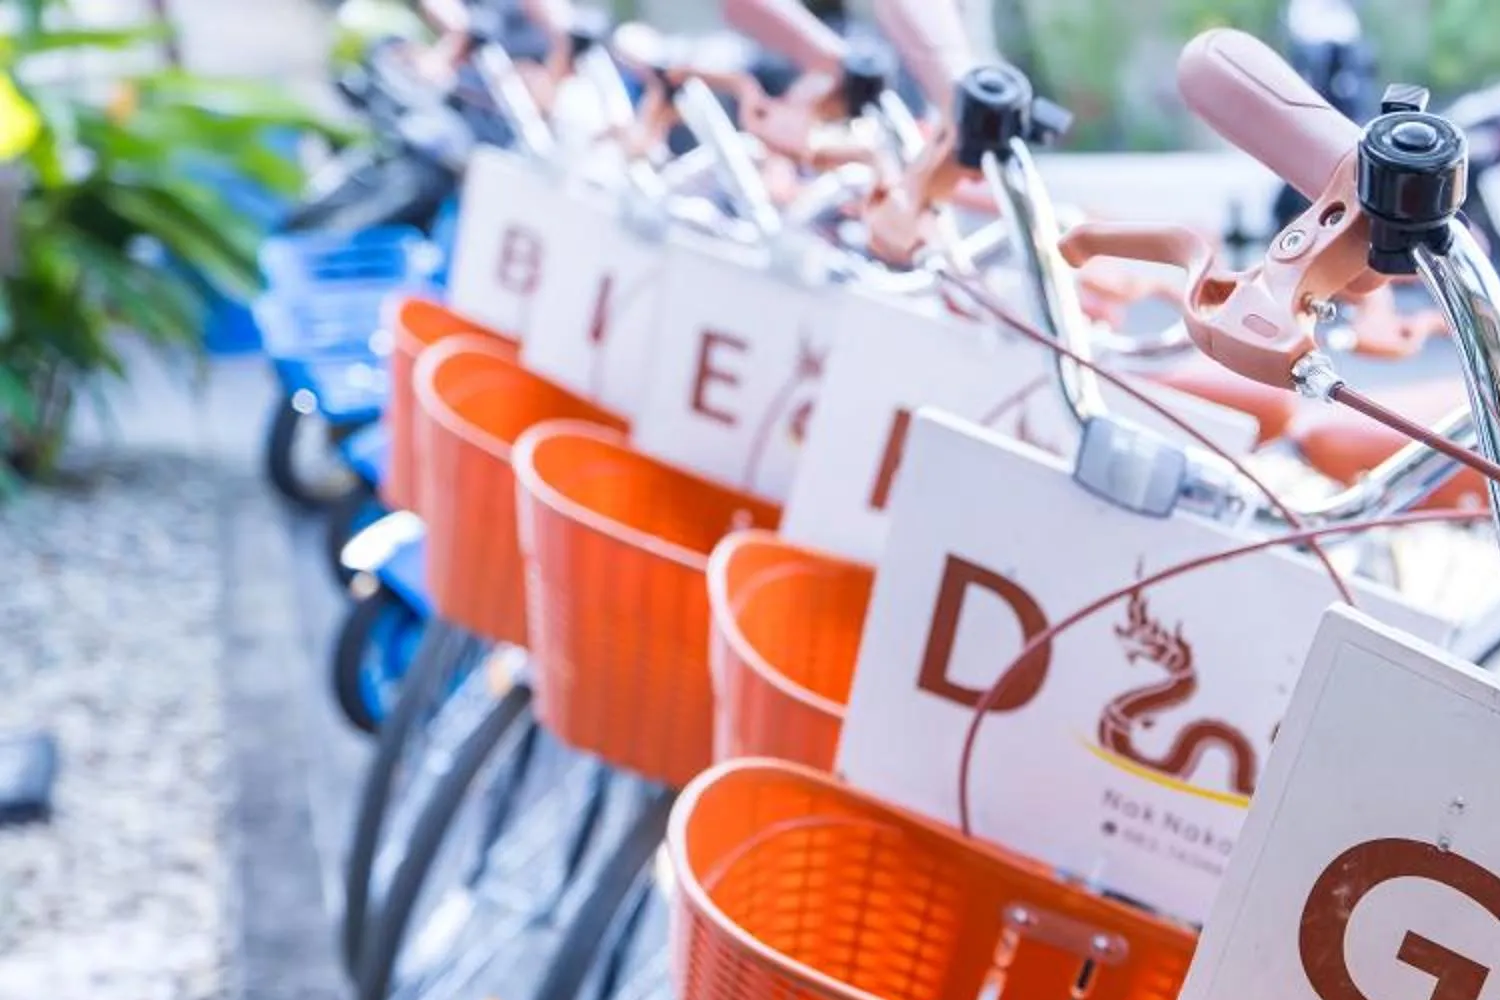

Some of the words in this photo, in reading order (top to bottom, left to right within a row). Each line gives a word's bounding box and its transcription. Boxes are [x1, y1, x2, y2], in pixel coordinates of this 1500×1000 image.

[498, 224, 543, 295] B
[690, 329, 748, 426] E
[916, 553, 1052, 713] D
